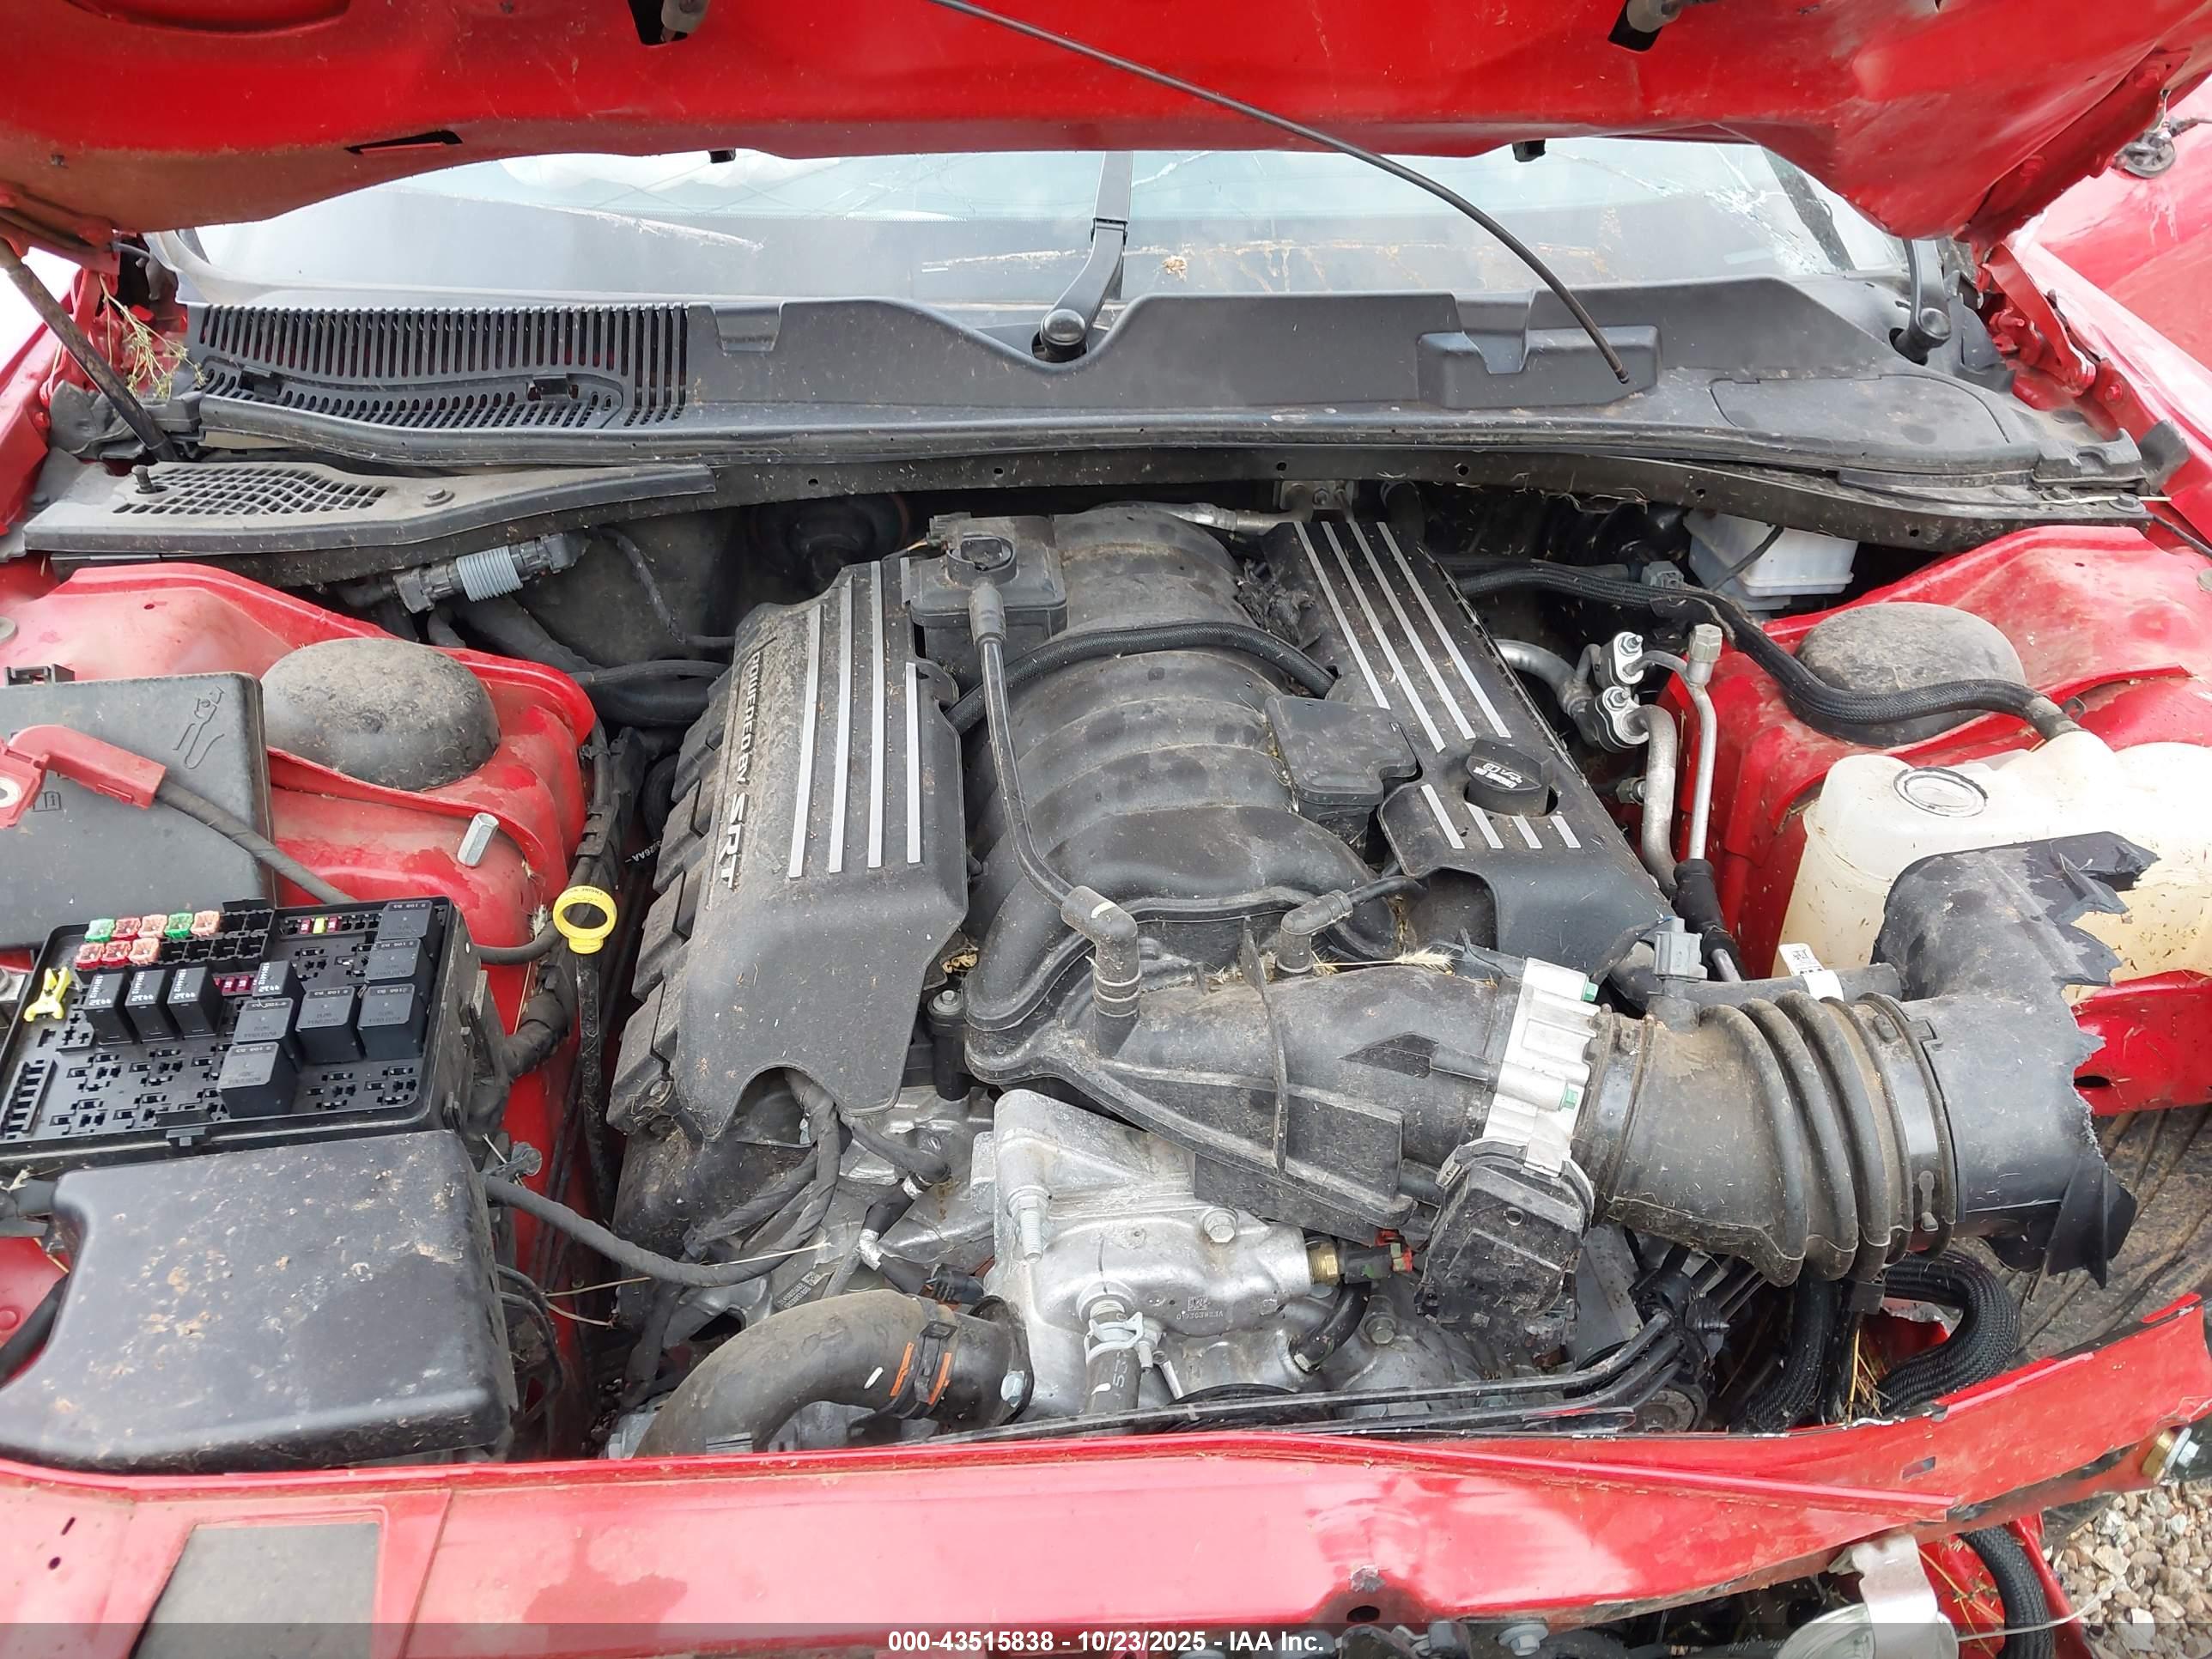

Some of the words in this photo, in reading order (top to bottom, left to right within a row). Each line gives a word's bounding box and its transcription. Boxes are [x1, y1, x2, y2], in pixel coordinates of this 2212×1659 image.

[741, 651, 763, 753] POWERED
[736, 754, 753, 786] BY
[717, 793, 748, 890] SRT
